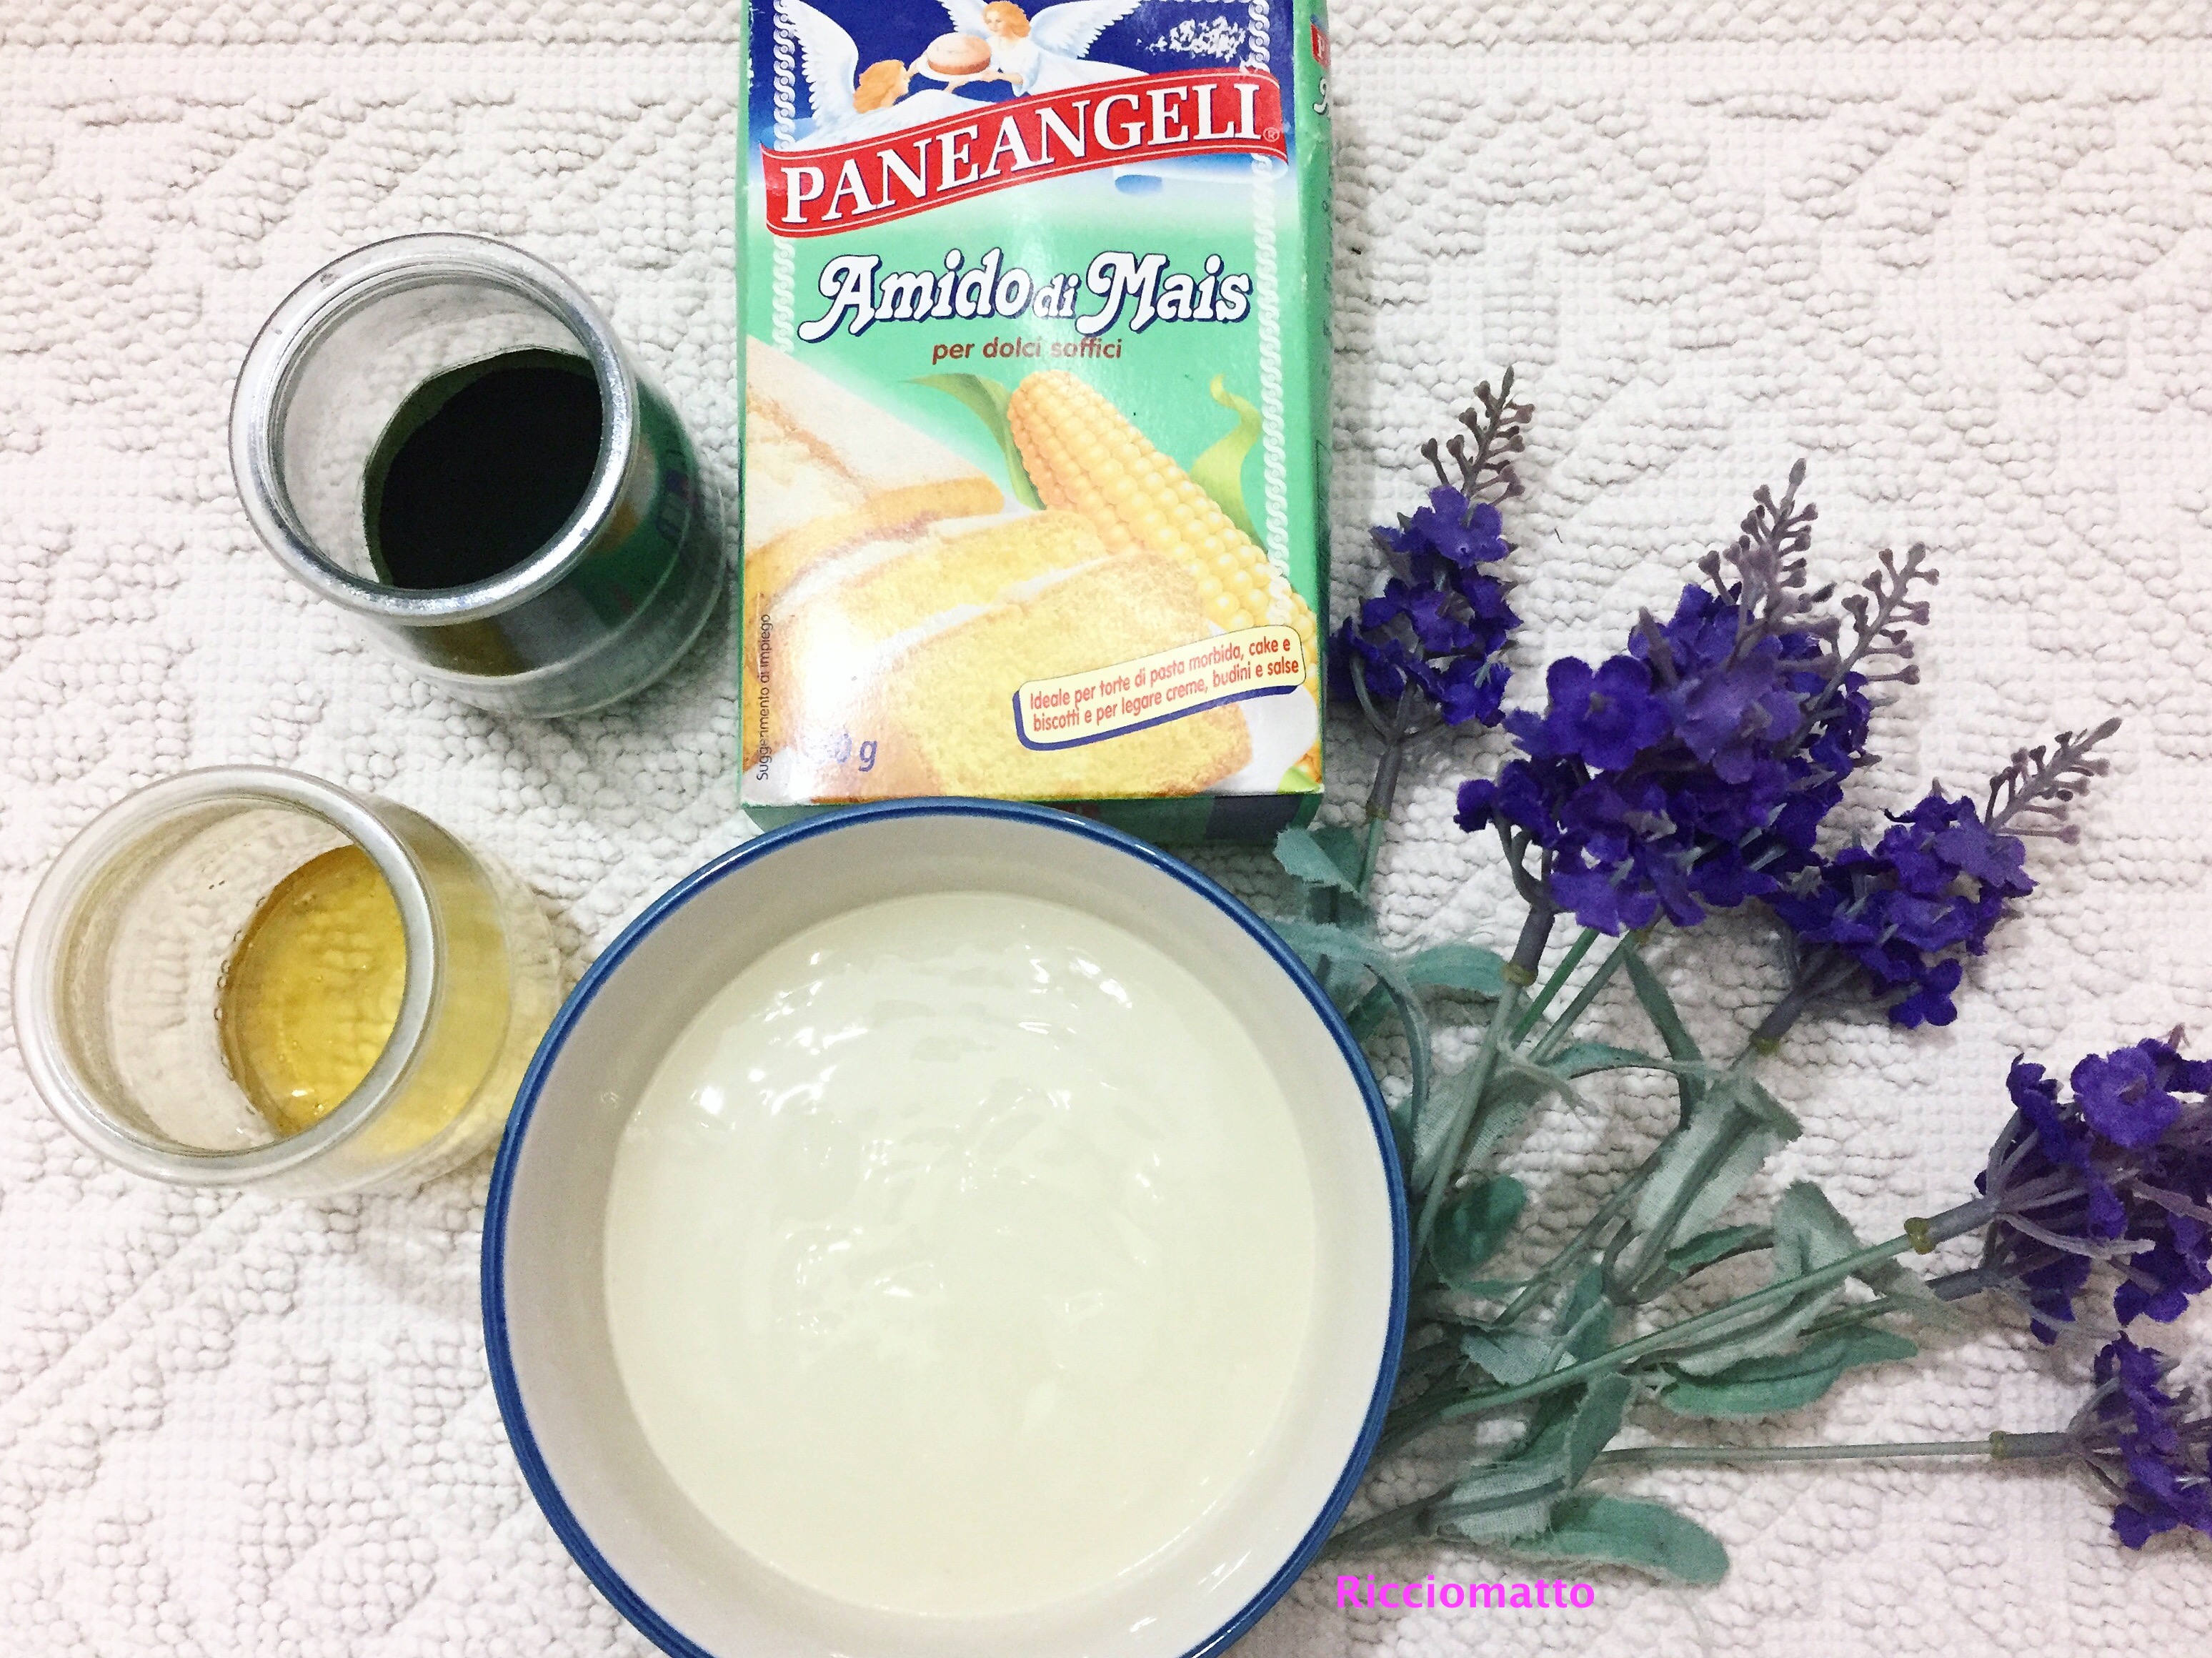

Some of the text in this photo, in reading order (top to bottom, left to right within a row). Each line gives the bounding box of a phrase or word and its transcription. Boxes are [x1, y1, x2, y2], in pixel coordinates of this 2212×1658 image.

[780, 82, 1263, 224] PANEANGELI
[797, 247, 1254, 342] Amido di Mais
[932, 336, 1122, 366] per dolci soffici
[756, 613, 774, 781] Suggerimento di impiego
[1030, 635, 1291, 711] Ideale per torte di pasta morbida, cake e
[1032, 655, 1300, 733] biscotti e per legare creme, budini e salse
[858, 740, 878, 773] g
